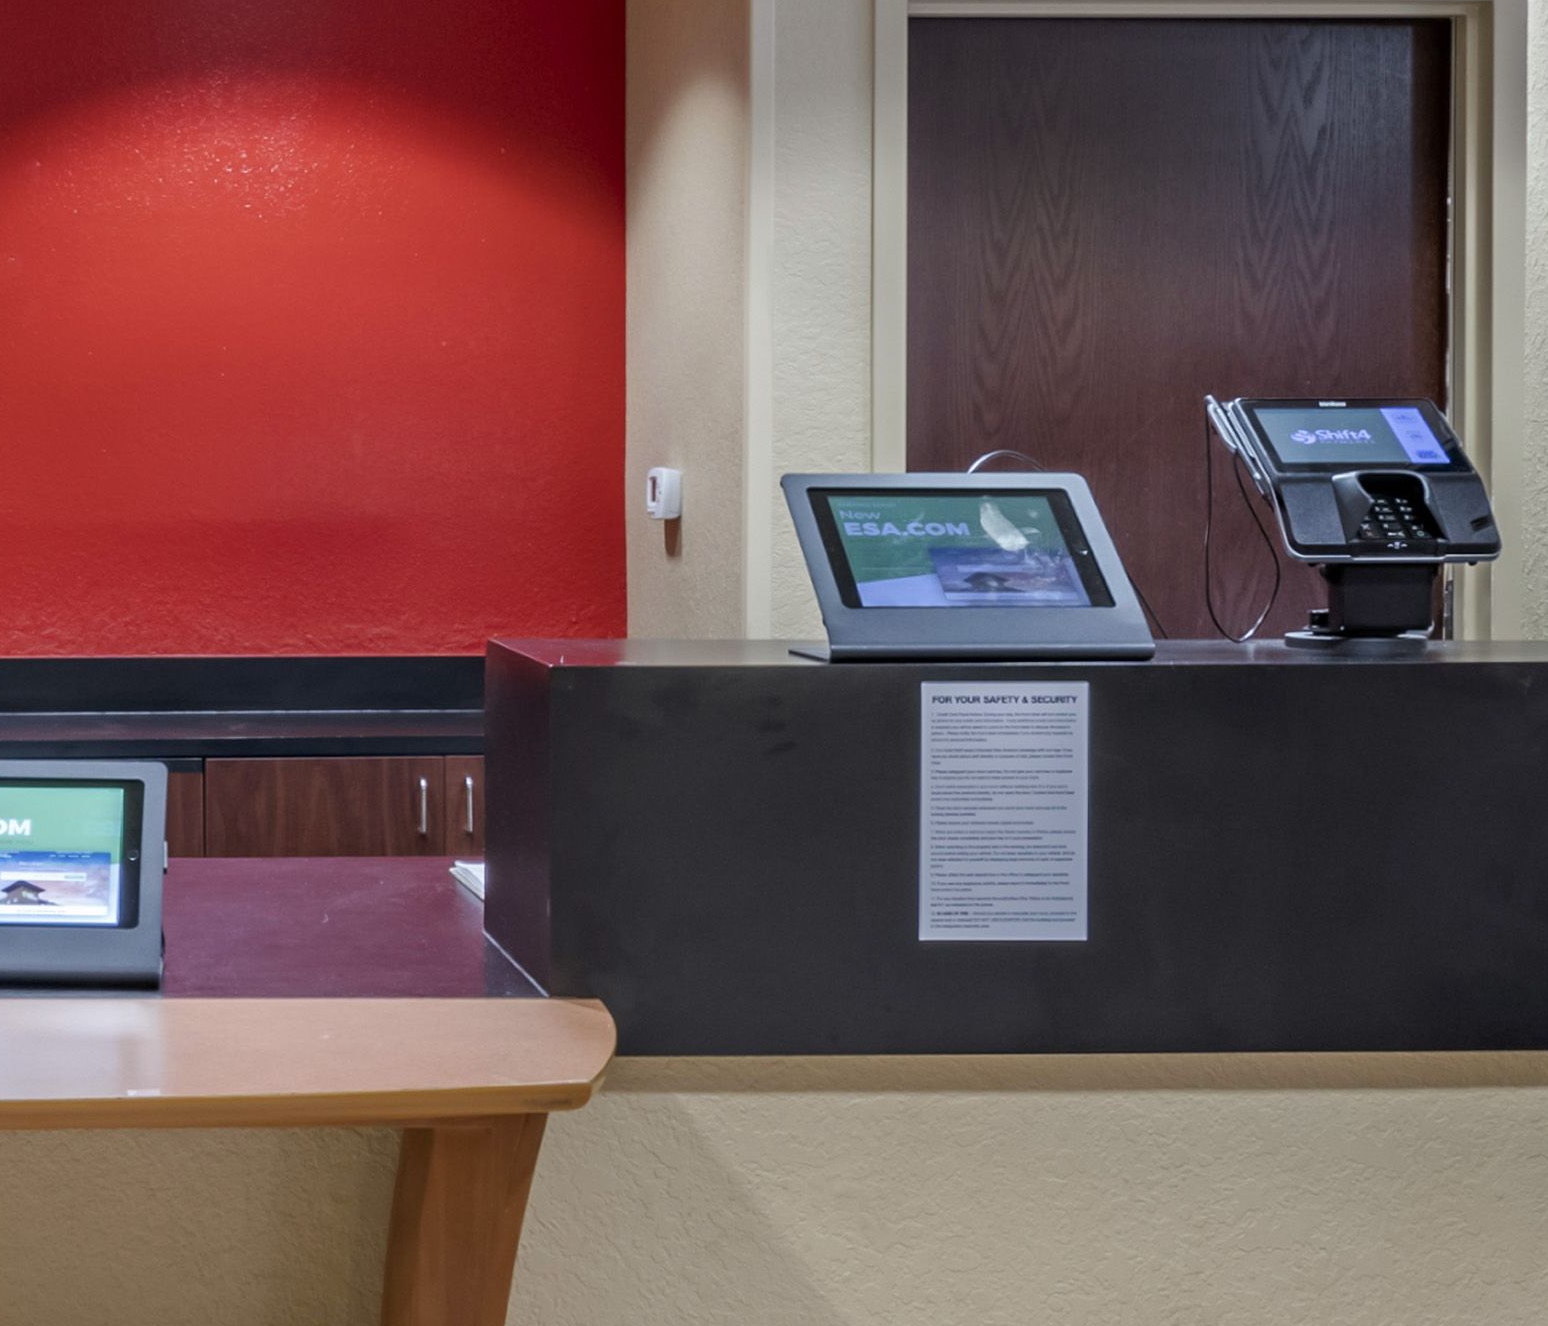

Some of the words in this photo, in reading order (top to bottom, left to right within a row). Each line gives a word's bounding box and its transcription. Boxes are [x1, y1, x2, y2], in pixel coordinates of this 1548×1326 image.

[1315, 429, 1372, 440] Shift4
[839, 510, 881, 520] New
[843, 522, 970, 536] ESA.COM
[931, 695, 952, 704] FOR
[954, 695, 981, 704] YOUR
[983, 695, 1020, 704] SAFETY
[1021, 695, 1029, 704] &
[1031, 695, 1078, 704] SECURITY
